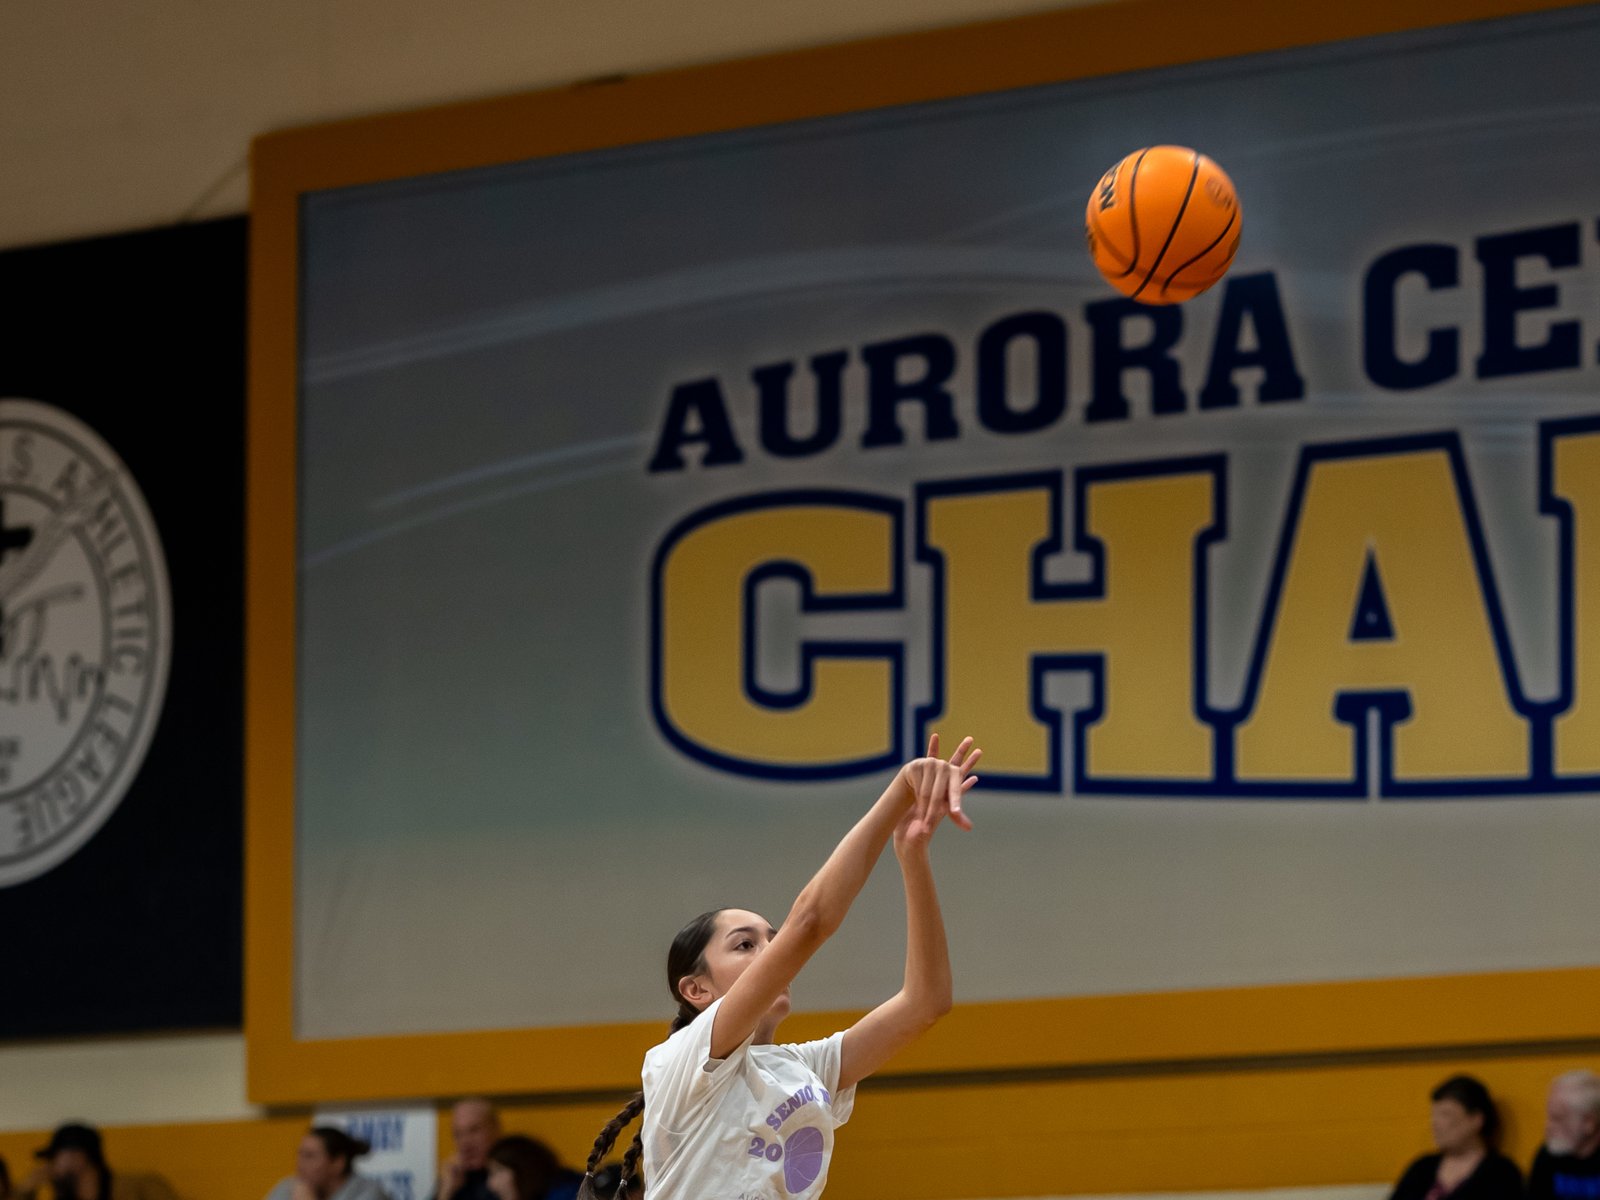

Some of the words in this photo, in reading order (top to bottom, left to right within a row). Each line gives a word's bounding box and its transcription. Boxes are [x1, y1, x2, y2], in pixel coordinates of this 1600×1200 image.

[647, 270, 1306, 474] AURORA
[1361, 217, 1600, 391] CE
[765, 1085, 820, 1131] SENIO
[748, 1136, 783, 1162] 20
